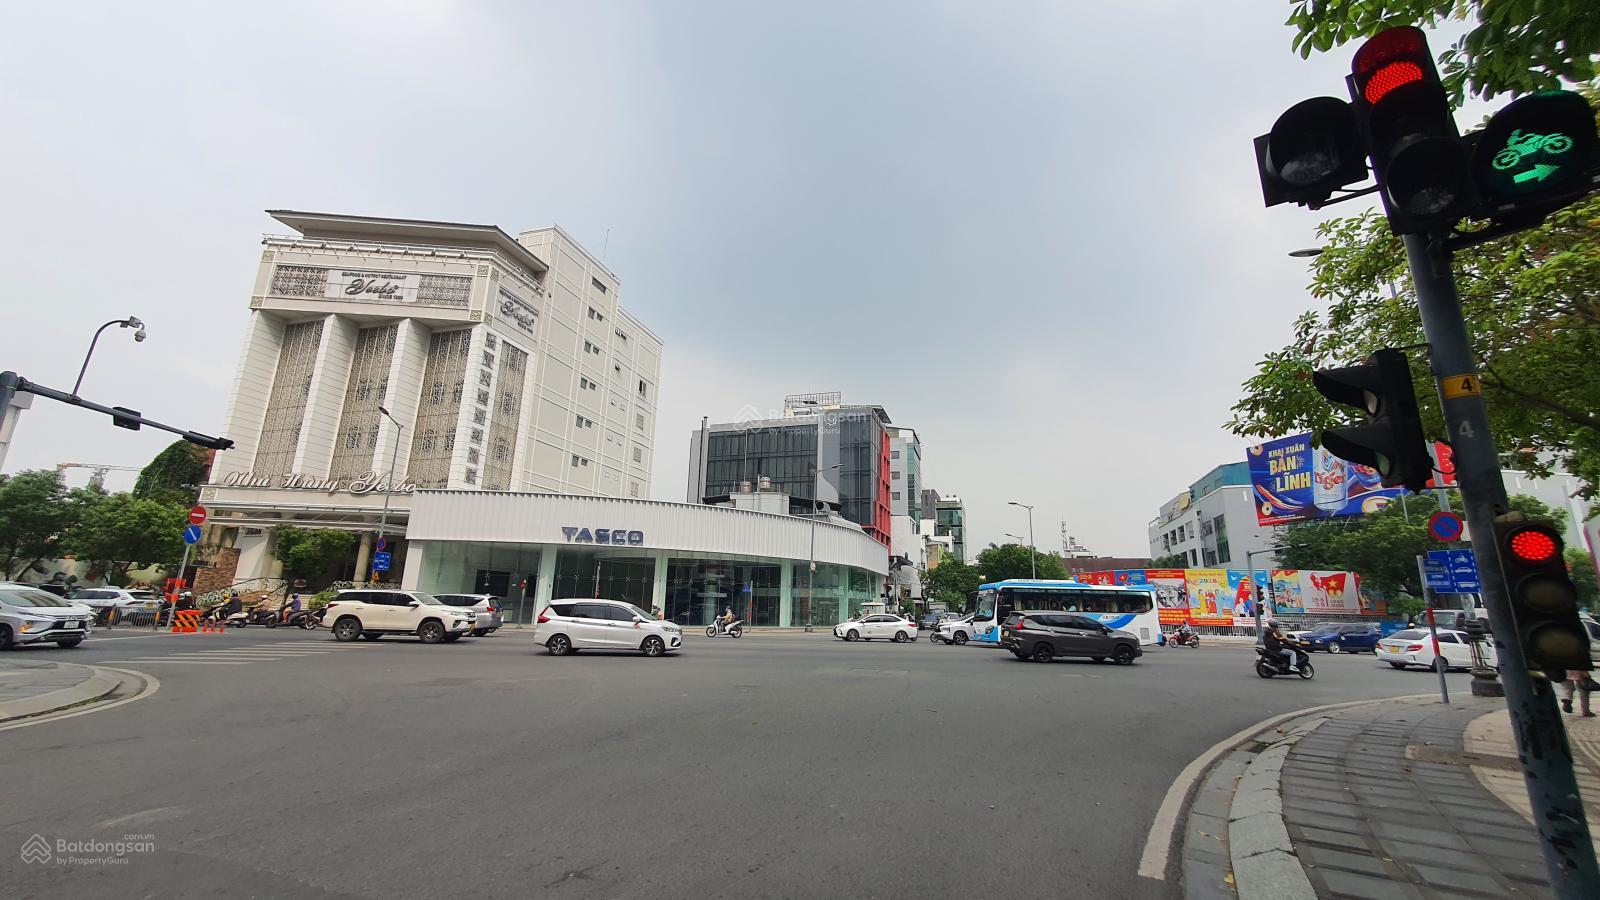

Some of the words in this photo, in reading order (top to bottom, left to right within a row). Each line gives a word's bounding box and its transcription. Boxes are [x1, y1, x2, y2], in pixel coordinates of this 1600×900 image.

[1461, 378, 1473, 391] 4
[1459, 420, 1476, 439] 4
[224, 471, 270, 488] Nhà
[280, 473, 340, 493] Hàng
[561, 526, 644, 547] TASCO
